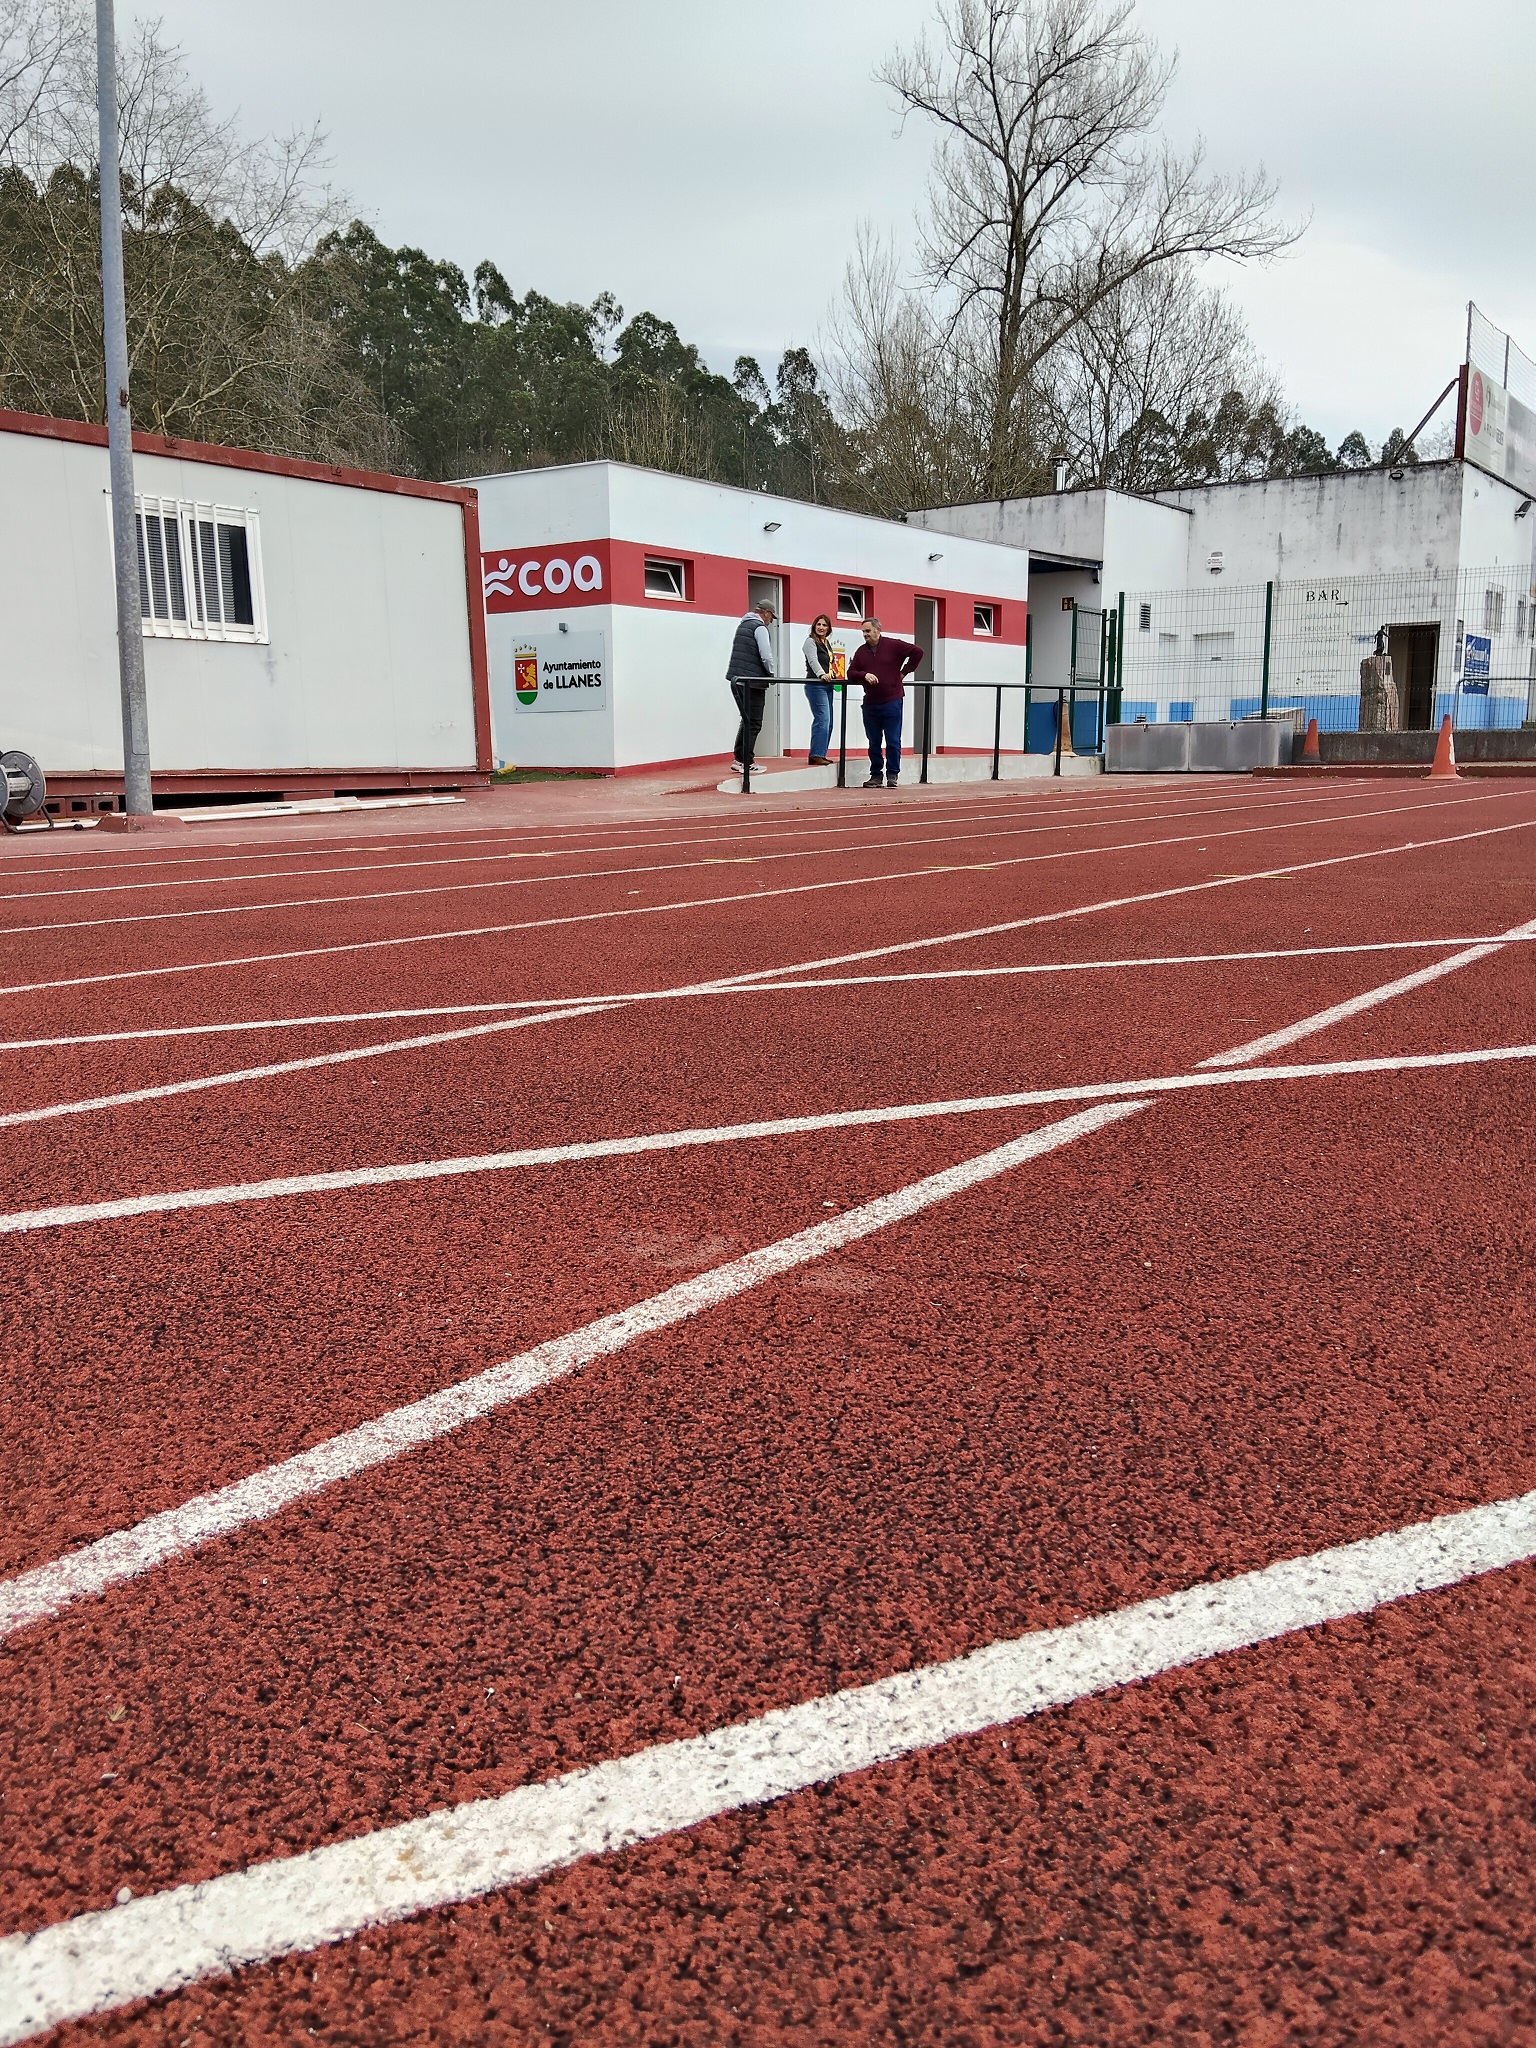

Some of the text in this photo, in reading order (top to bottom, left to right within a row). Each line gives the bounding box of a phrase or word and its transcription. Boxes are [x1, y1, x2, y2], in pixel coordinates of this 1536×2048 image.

[1306, 589, 1340, 602] BAR
[543, 658, 602, 674] Ayuntamiento
[543, 673, 602, 690] de LLANES
